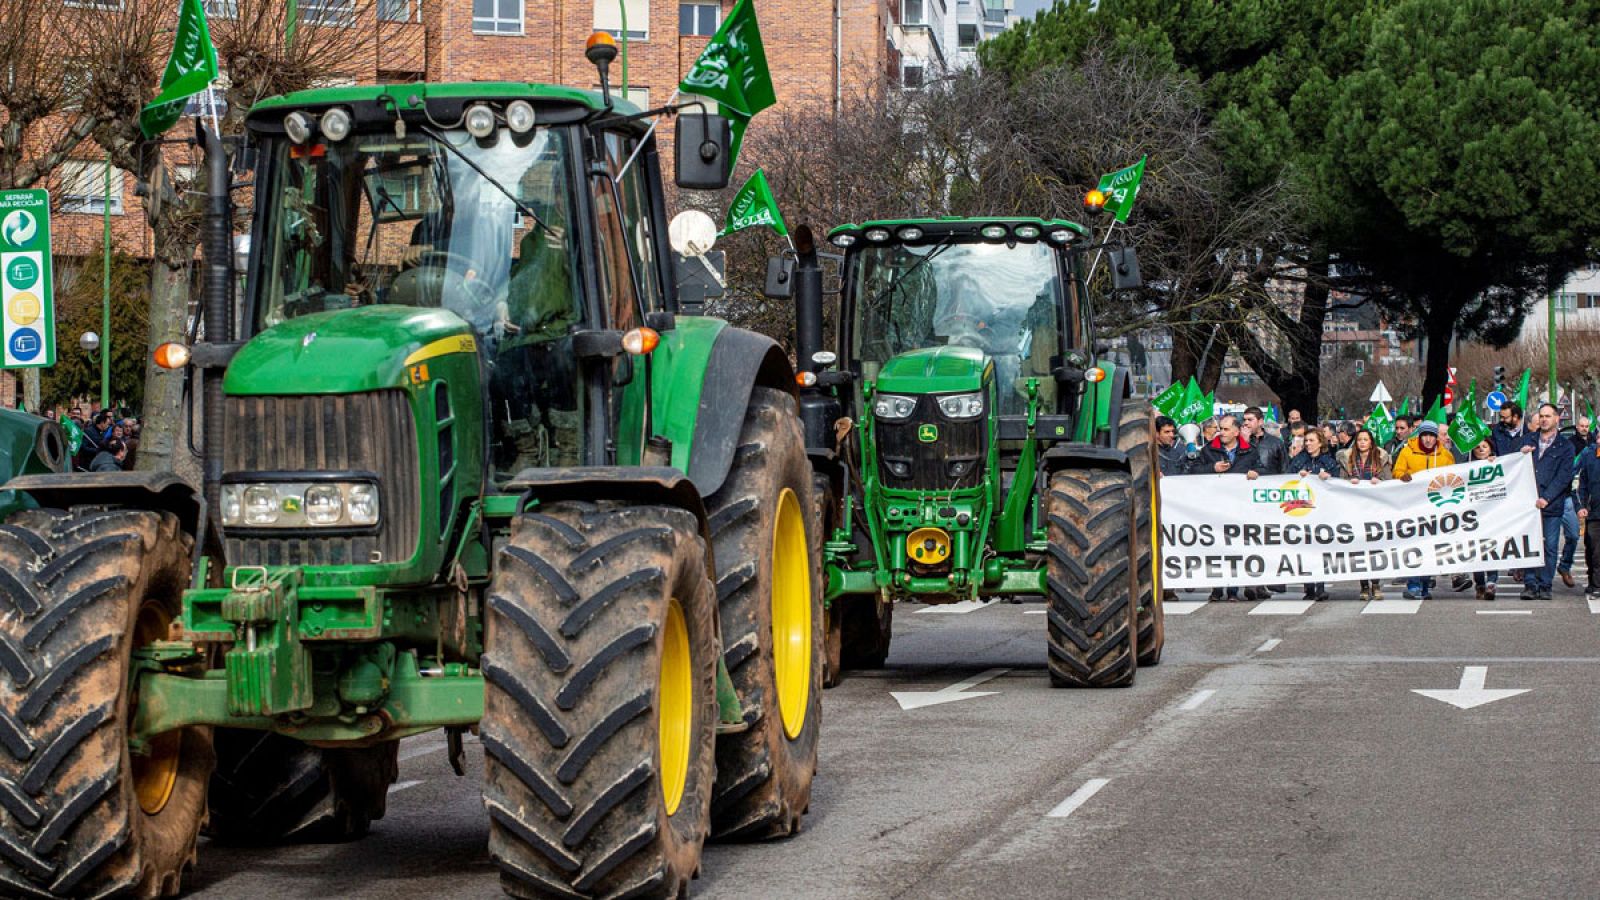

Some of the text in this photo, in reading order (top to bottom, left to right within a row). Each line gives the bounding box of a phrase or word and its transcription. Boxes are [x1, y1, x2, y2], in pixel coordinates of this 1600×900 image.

[685, 65, 729, 90] UPA
[5, 193, 34, 201] SEPARAR
[1468, 463, 1505, 486] UPA
[1253, 489, 1310, 503] COAG
[1161, 509, 1479, 547] NOS PRECIOS DIGNOS
[1164, 534, 1541, 579] SPETO AL MEDIO RURAL
